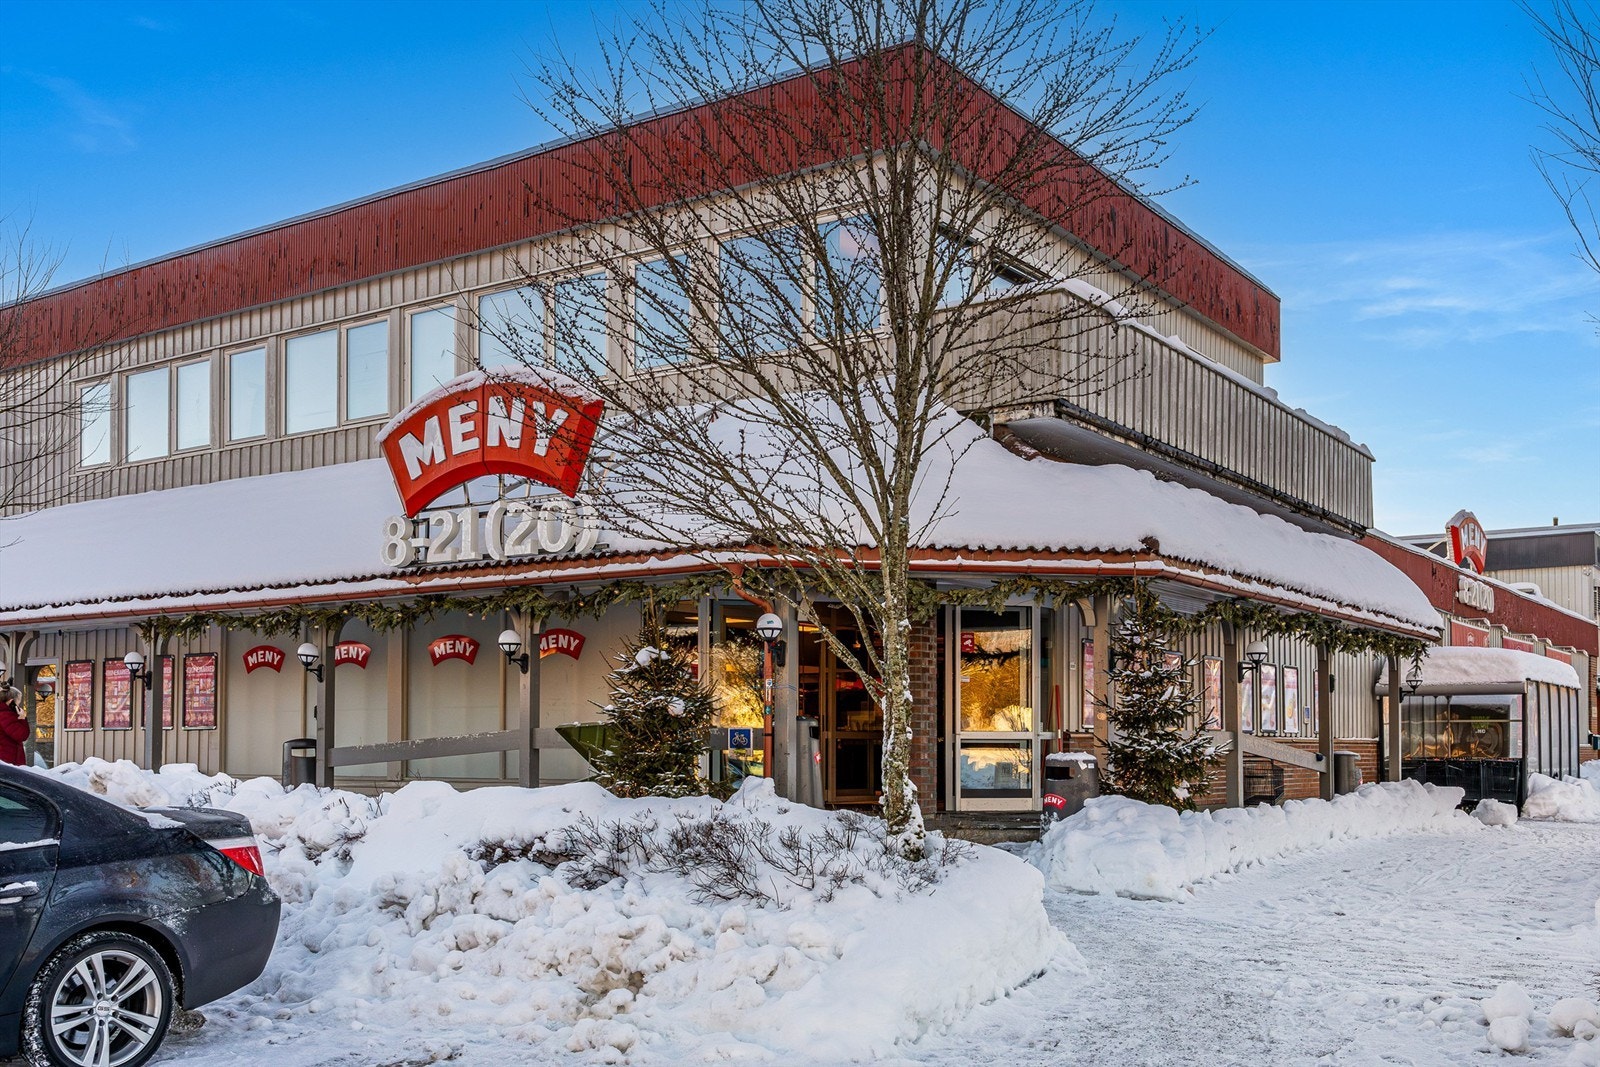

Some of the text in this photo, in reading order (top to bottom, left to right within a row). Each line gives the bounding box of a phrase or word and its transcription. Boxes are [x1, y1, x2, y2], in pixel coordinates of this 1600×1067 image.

[399, 396, 569, 481] MENY
[381, 495, 600, 567] 8-21(20)
[1461, 522, 1487, 556] MENY
[247, 650, 281, 666] MENY
[433, 640, 474, 658] MENY
